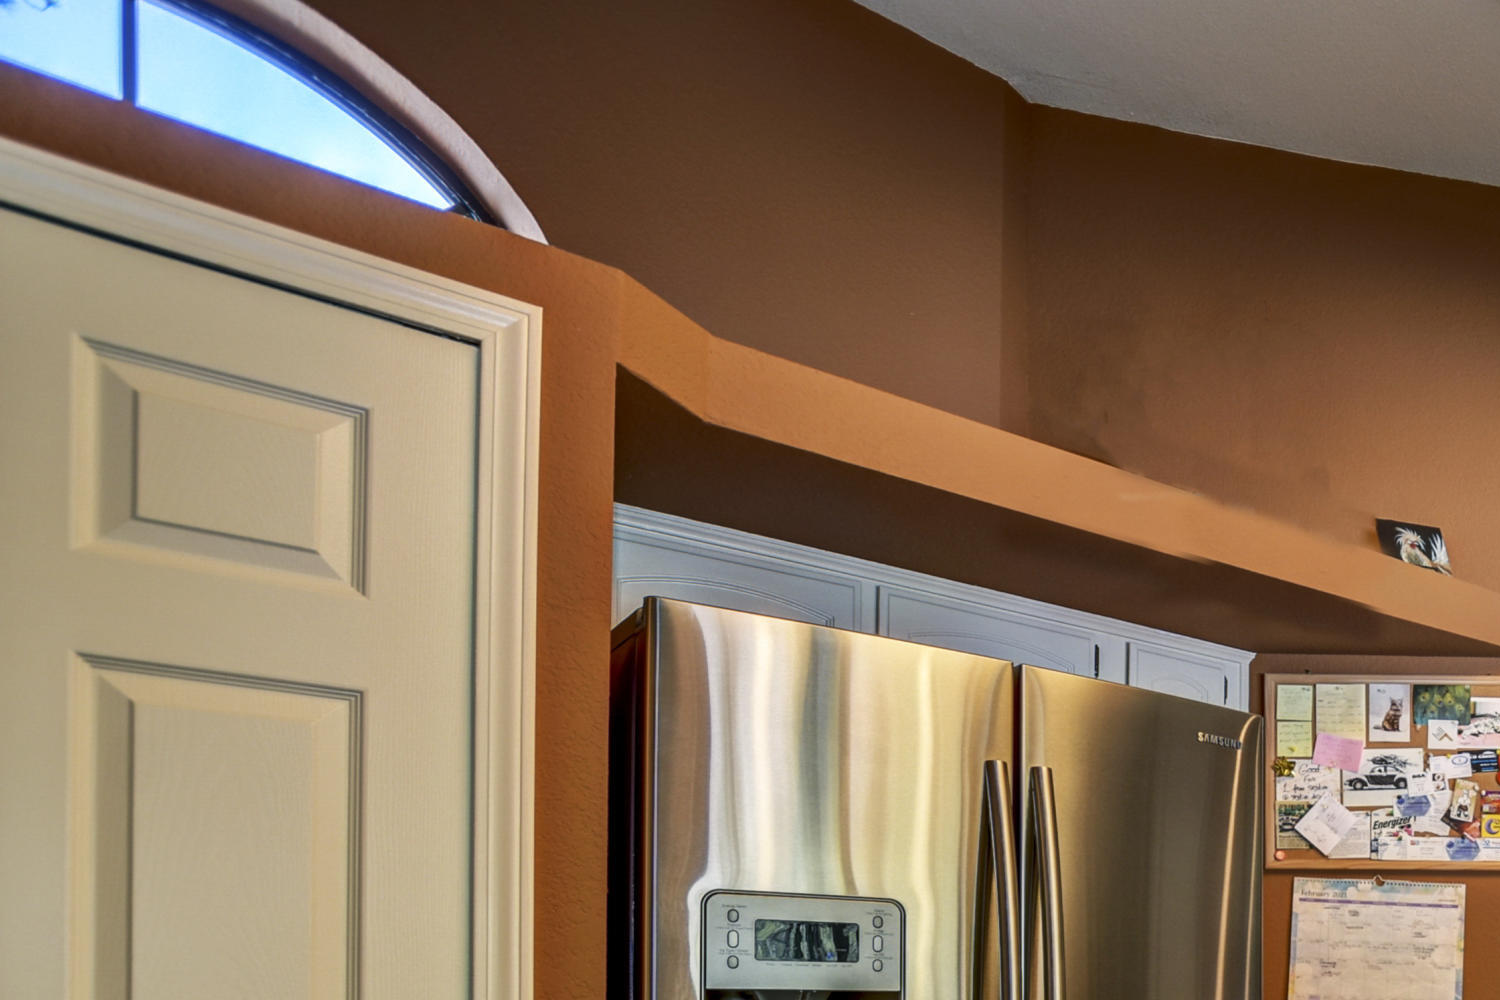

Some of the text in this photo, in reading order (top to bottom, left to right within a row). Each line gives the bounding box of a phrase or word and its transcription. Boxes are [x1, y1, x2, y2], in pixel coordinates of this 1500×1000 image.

[1197, 731, 1243, 750] SAMSUNG
[1372, 815, 1412, 830] Energizer
[1301, 889, 1330, 898] February
